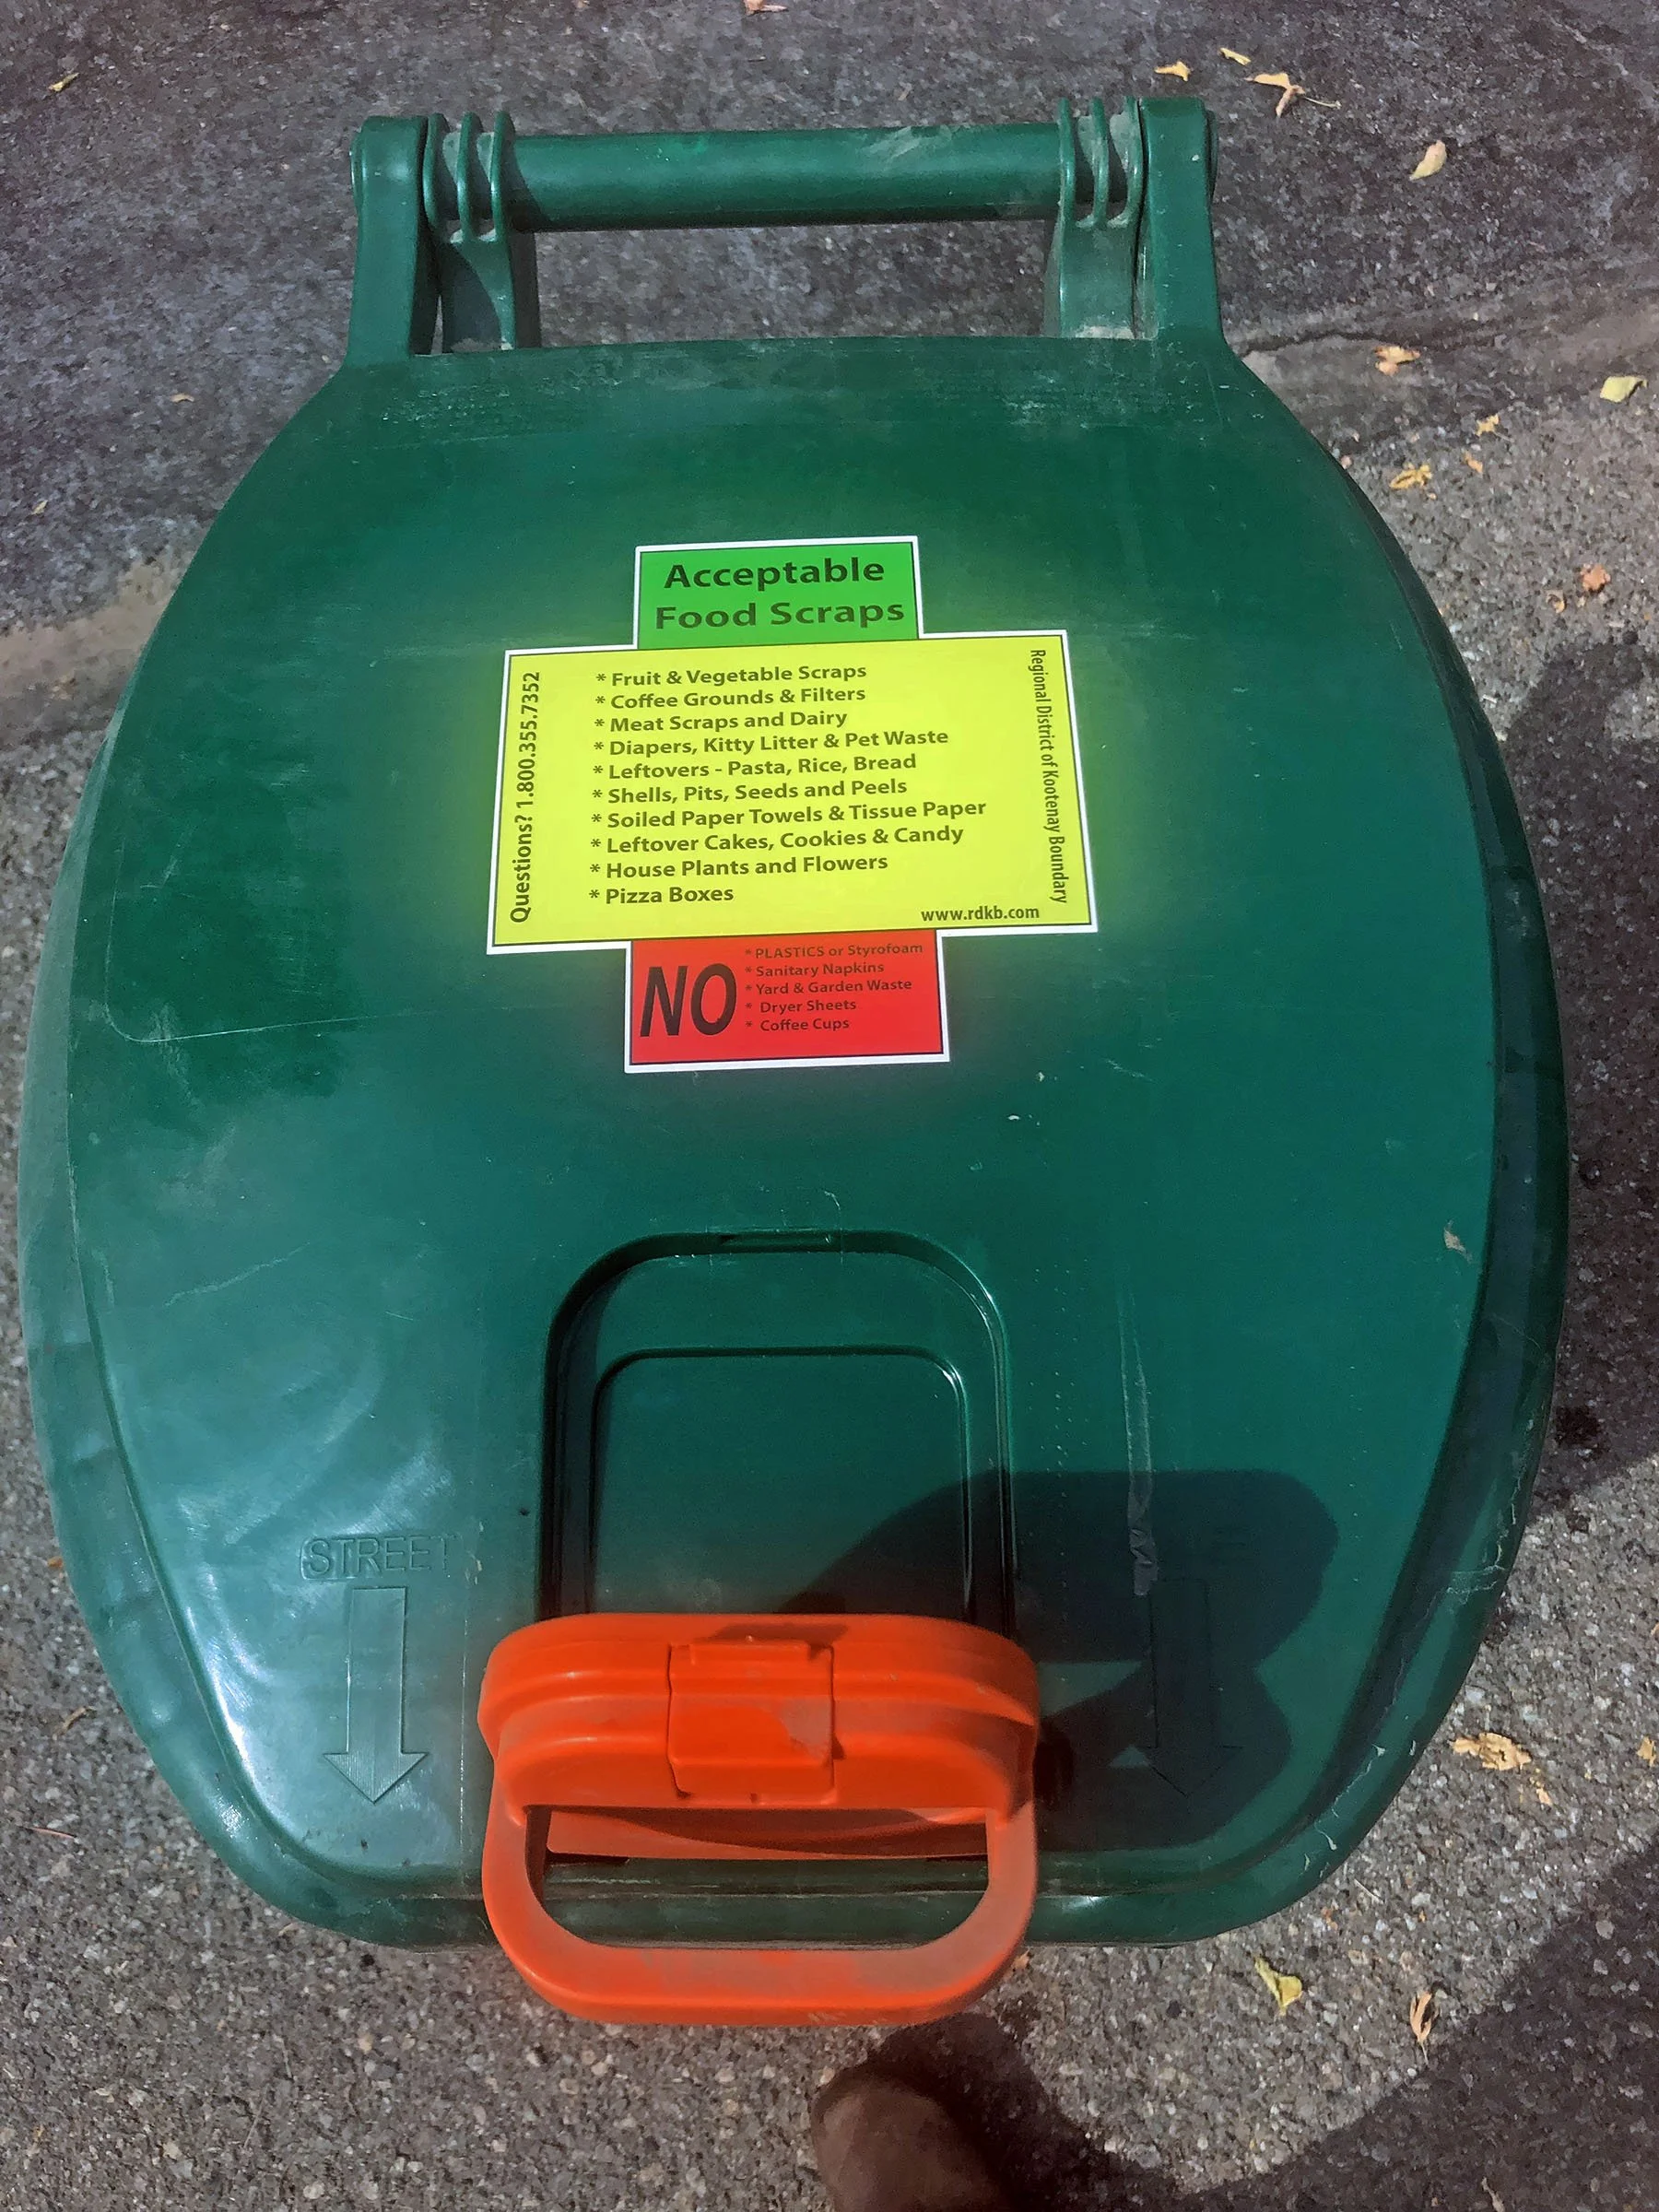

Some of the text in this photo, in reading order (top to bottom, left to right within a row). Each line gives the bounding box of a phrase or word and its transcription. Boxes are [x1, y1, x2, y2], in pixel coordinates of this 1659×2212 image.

[664, 556, 885, 592] Acceptable
[655, 602, 905, 629] Food Scraps
[612, 665, 867, 687] Fruit & Vegetable Scraps
[610, 687, 866, 710] Coffee Grounds & Filters
[610, 710, 848, 733] Meat Scraps and Dairy
[609, 730, 949, 759] Diapers, Kitty Litter & Pet Waste
[608, 762, 710, 780] Leftovers
[728, 760, 793, 776] Pasta,
[798, 757, 848, 774] Rice,
[853, 752, 917, 771] Bread
[1028, 649, 1070, 904] Regional District of Kootenay Boundary
[510, 672, 540, 924] Questions? 1.800.355.7352
[607, 778, 908, 805] Shells, Pits, Seeds and Peels
[606, 801, 987, 830] Soiled Paper Towels & Tissue Paper
[606, 824, 964, 853] Leftover Cakes, Cookies & Candy
[606, 855, 888, 879] House Plants and Flowers
[606, 886, 735, 905] Pizza Boxes
[920, 904, 1041, 922] www.rdkb.com
[754, 943, 924, 959] PLASTICS or Styrofoam
[755, 961, 885, 979] Sanitary Napkins
[755, 979, 912, 995] Yard & Garden Waste
[640, 962, 737, 1038] NO
[759, 999, 857, 1016] Dryer Sheets
[759, 1018, 850, 1032] Coffee Cups
